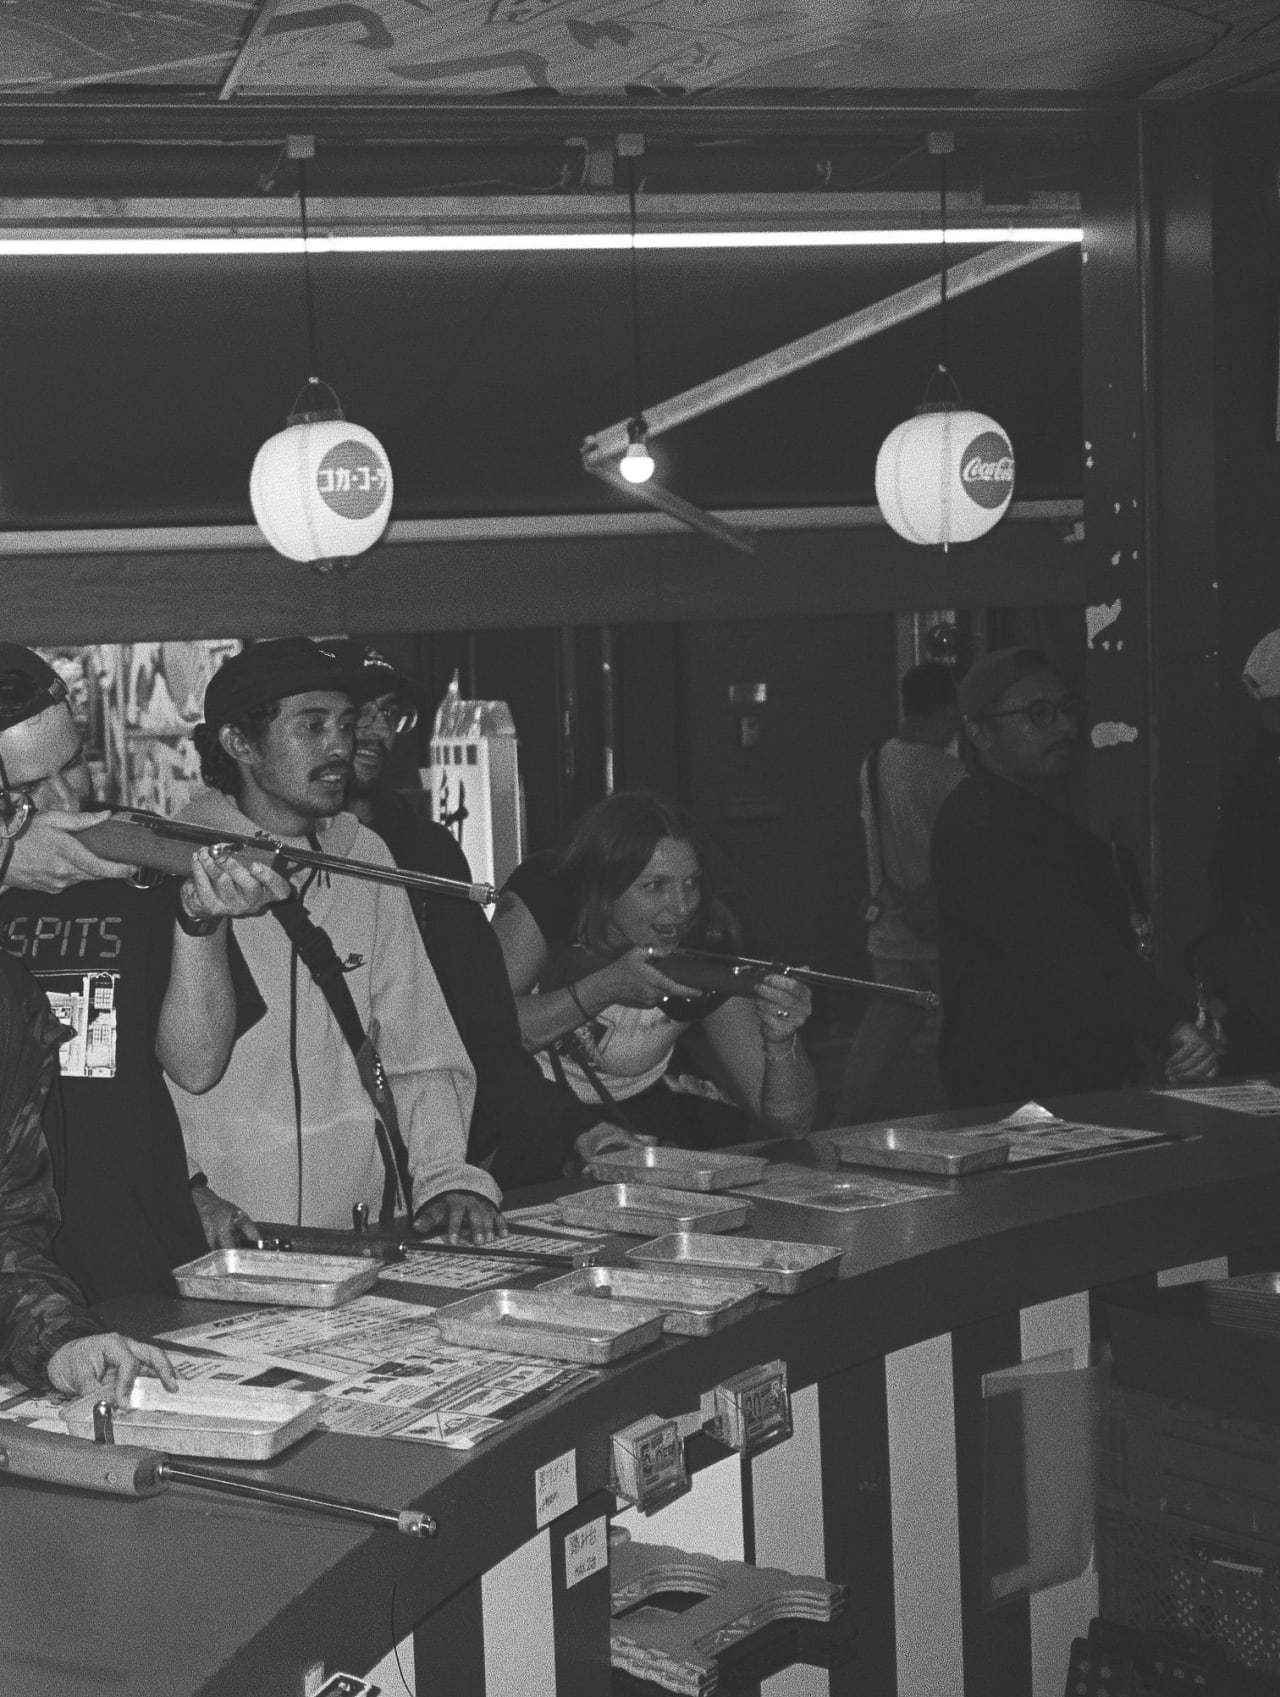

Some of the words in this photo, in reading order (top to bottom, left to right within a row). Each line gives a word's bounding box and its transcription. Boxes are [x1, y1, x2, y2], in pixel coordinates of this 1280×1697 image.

[318, 466, 387, 492] コカ・コーラ
